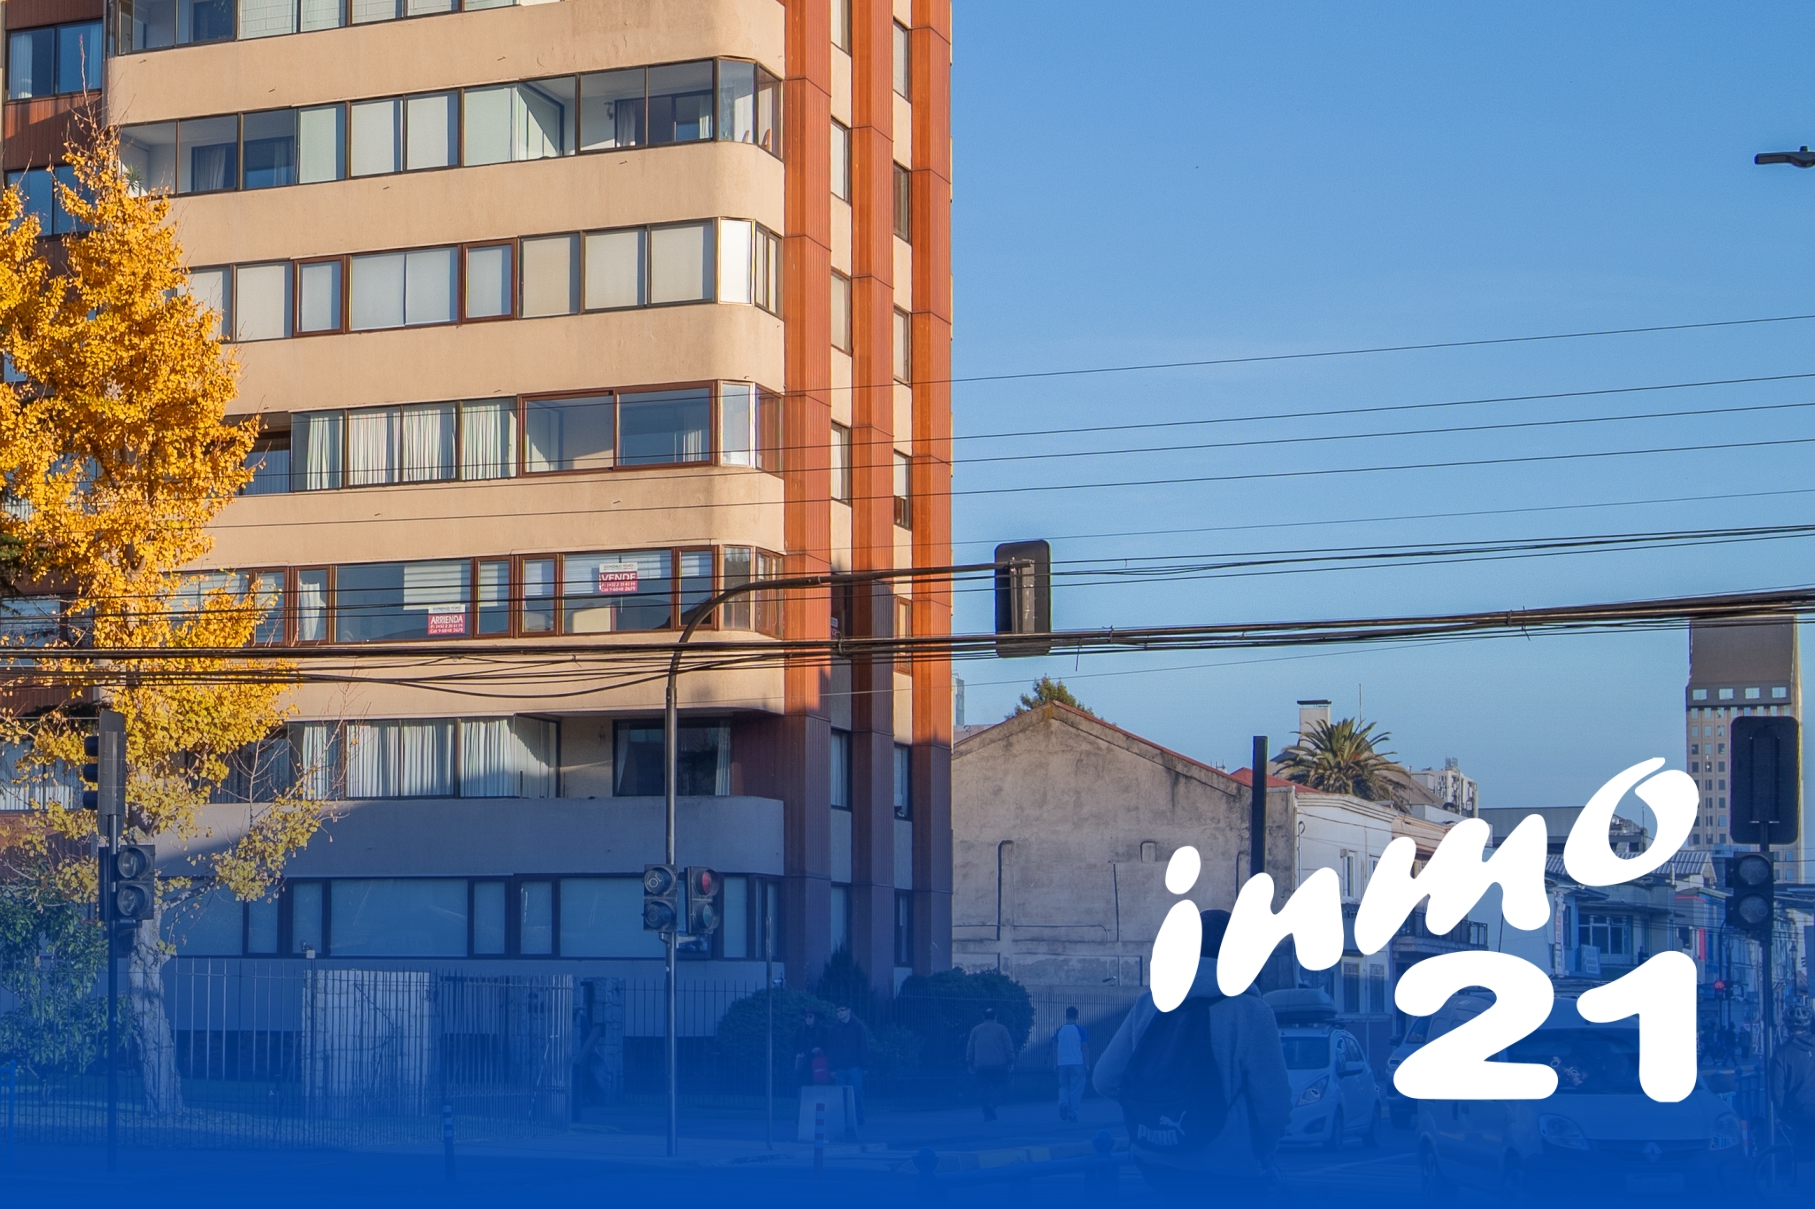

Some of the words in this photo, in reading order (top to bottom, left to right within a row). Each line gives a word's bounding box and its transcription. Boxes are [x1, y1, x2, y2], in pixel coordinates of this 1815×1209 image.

[601, 573, 636, 581] VENDE
[430, 615, 463, 624] ARRIENDA
[1136, 1123, 1179, 1147] PUMA
